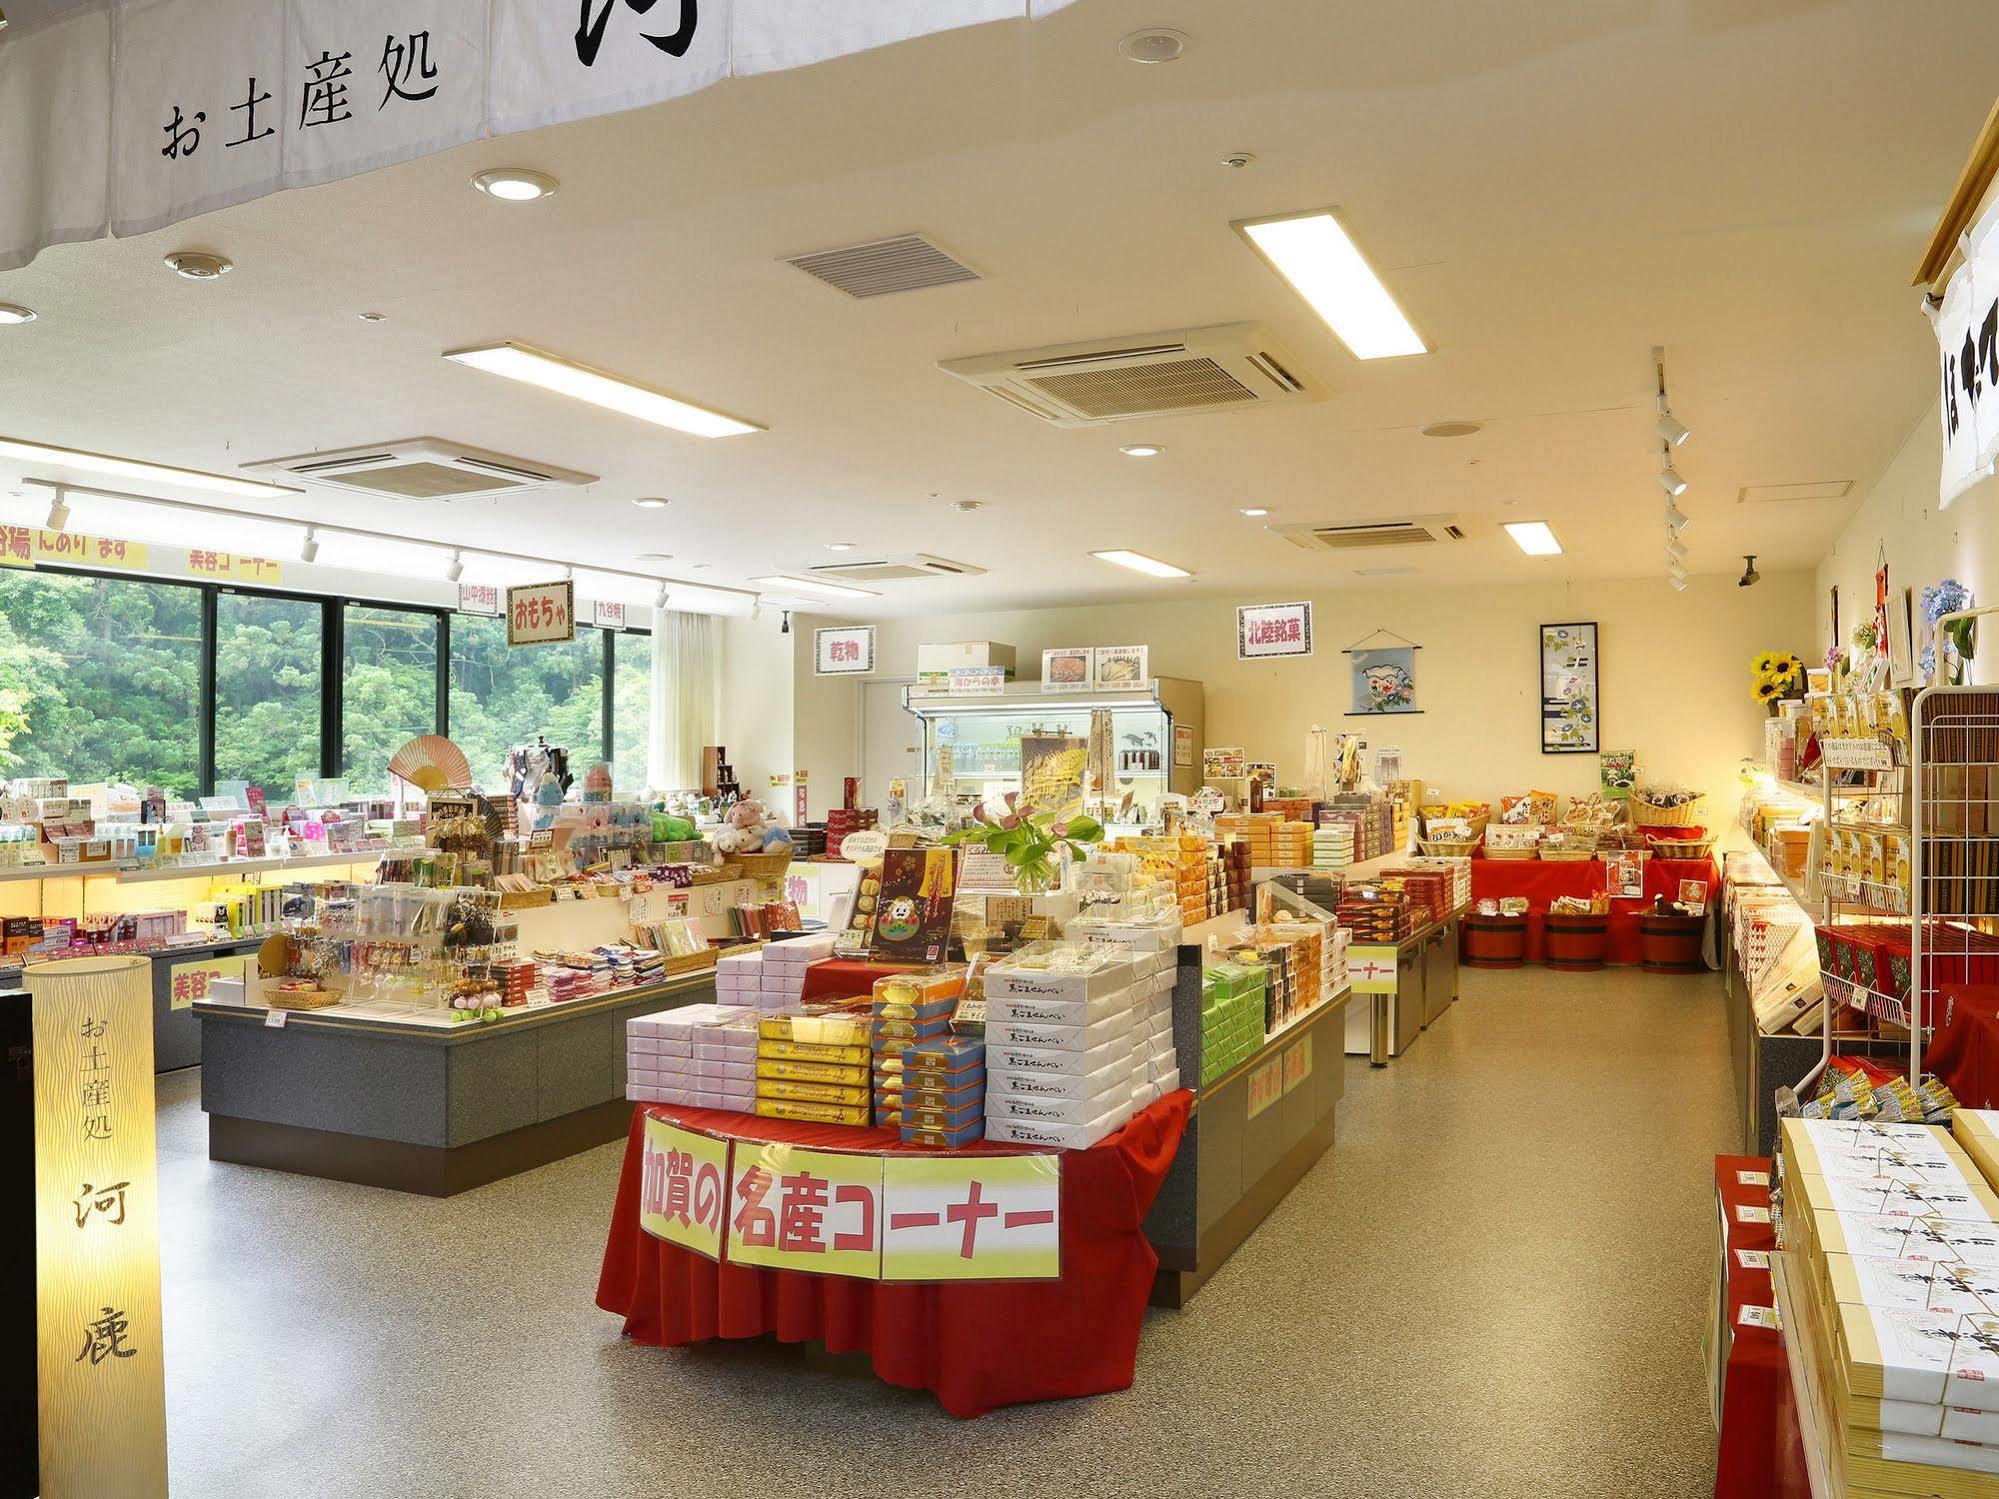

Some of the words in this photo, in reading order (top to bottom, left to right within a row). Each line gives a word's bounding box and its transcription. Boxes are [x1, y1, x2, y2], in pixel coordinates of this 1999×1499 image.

[160, 30, 440, 160] お土産処
[515, 596, 566, 631] おもちゃ
[829, 641, 859, 664] 乾物
[1248, 616, 1302, 646] 北陸銘菓
[81, 1017, 112, 1143] お土産処
[643, 1138, 1055, 1259] 加賀の名産コーナー
